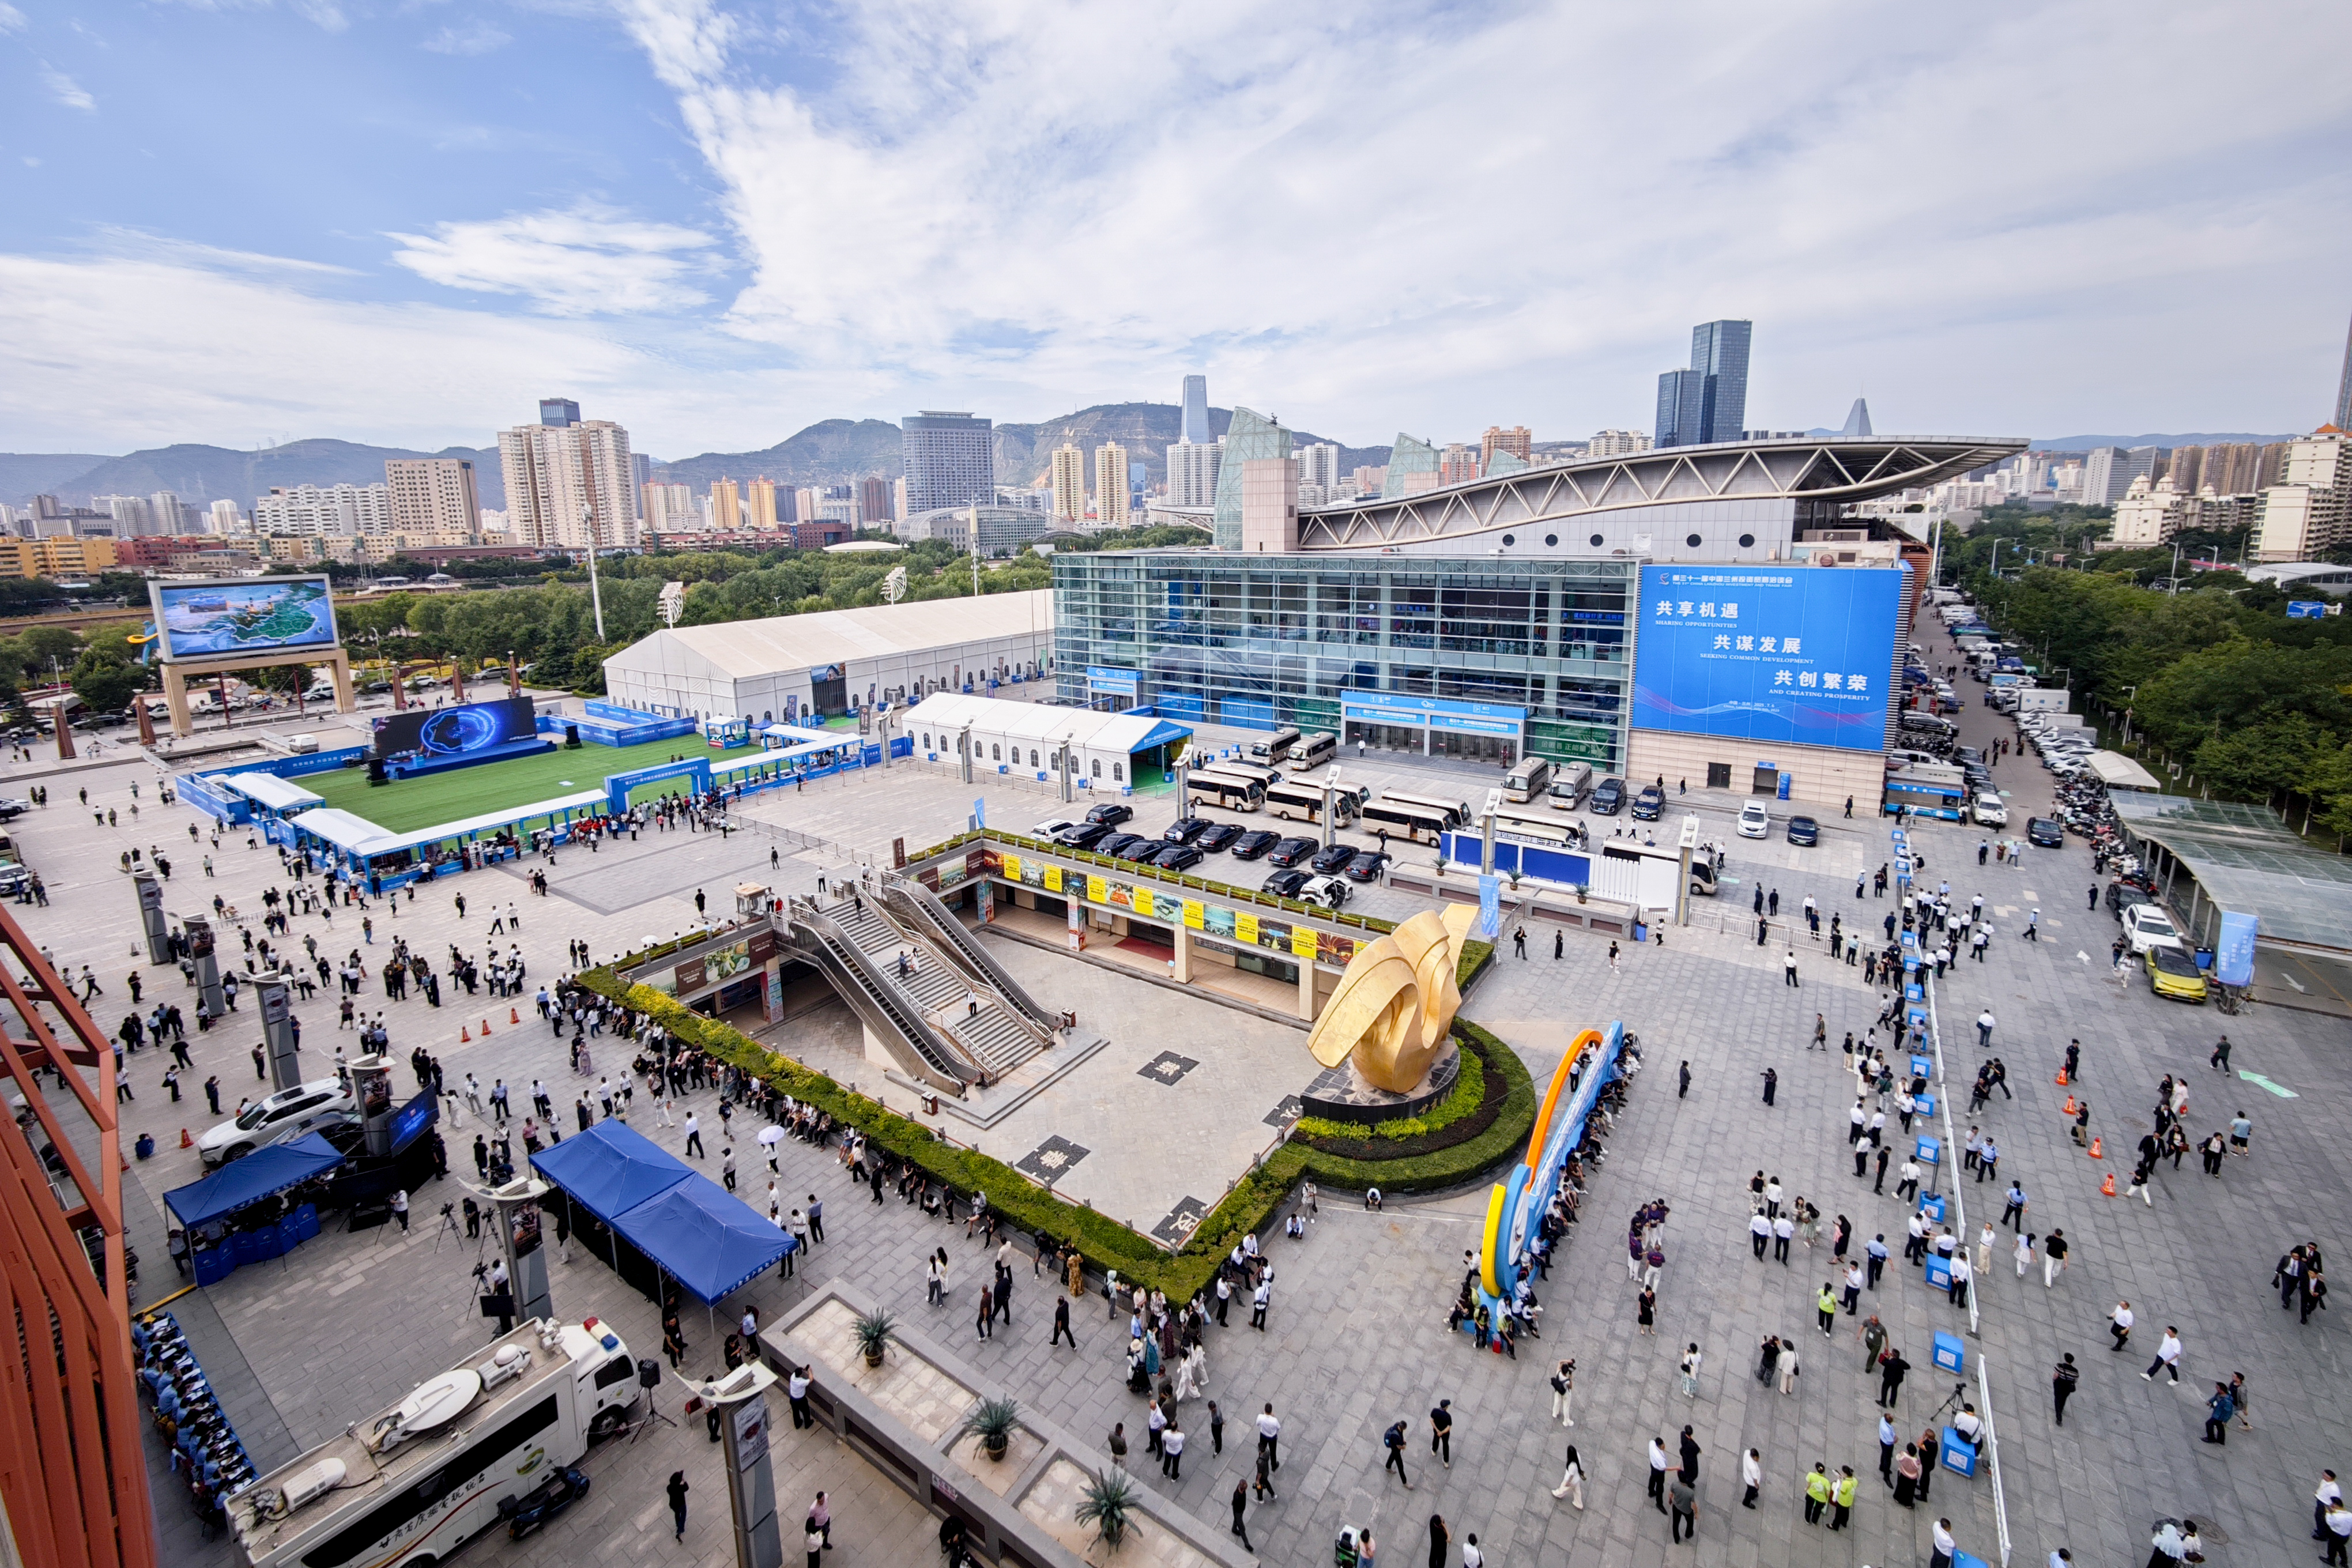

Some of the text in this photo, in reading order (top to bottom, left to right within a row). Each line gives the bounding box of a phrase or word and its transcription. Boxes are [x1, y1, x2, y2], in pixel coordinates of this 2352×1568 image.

[1672, 575, 1793, 584] 第三十一届中国兰州投资贸易洽谈会
[1656, 600, 1739, 619] 共享机遇
[1713, 634, 1801, 654] 共谋发展
[1762, 656, 1814, 665] DEVELOPMENT
[1774, 669, 1868, 692] 共创繁荣
[1824, 693, 1871, 701] PROSPERITY
